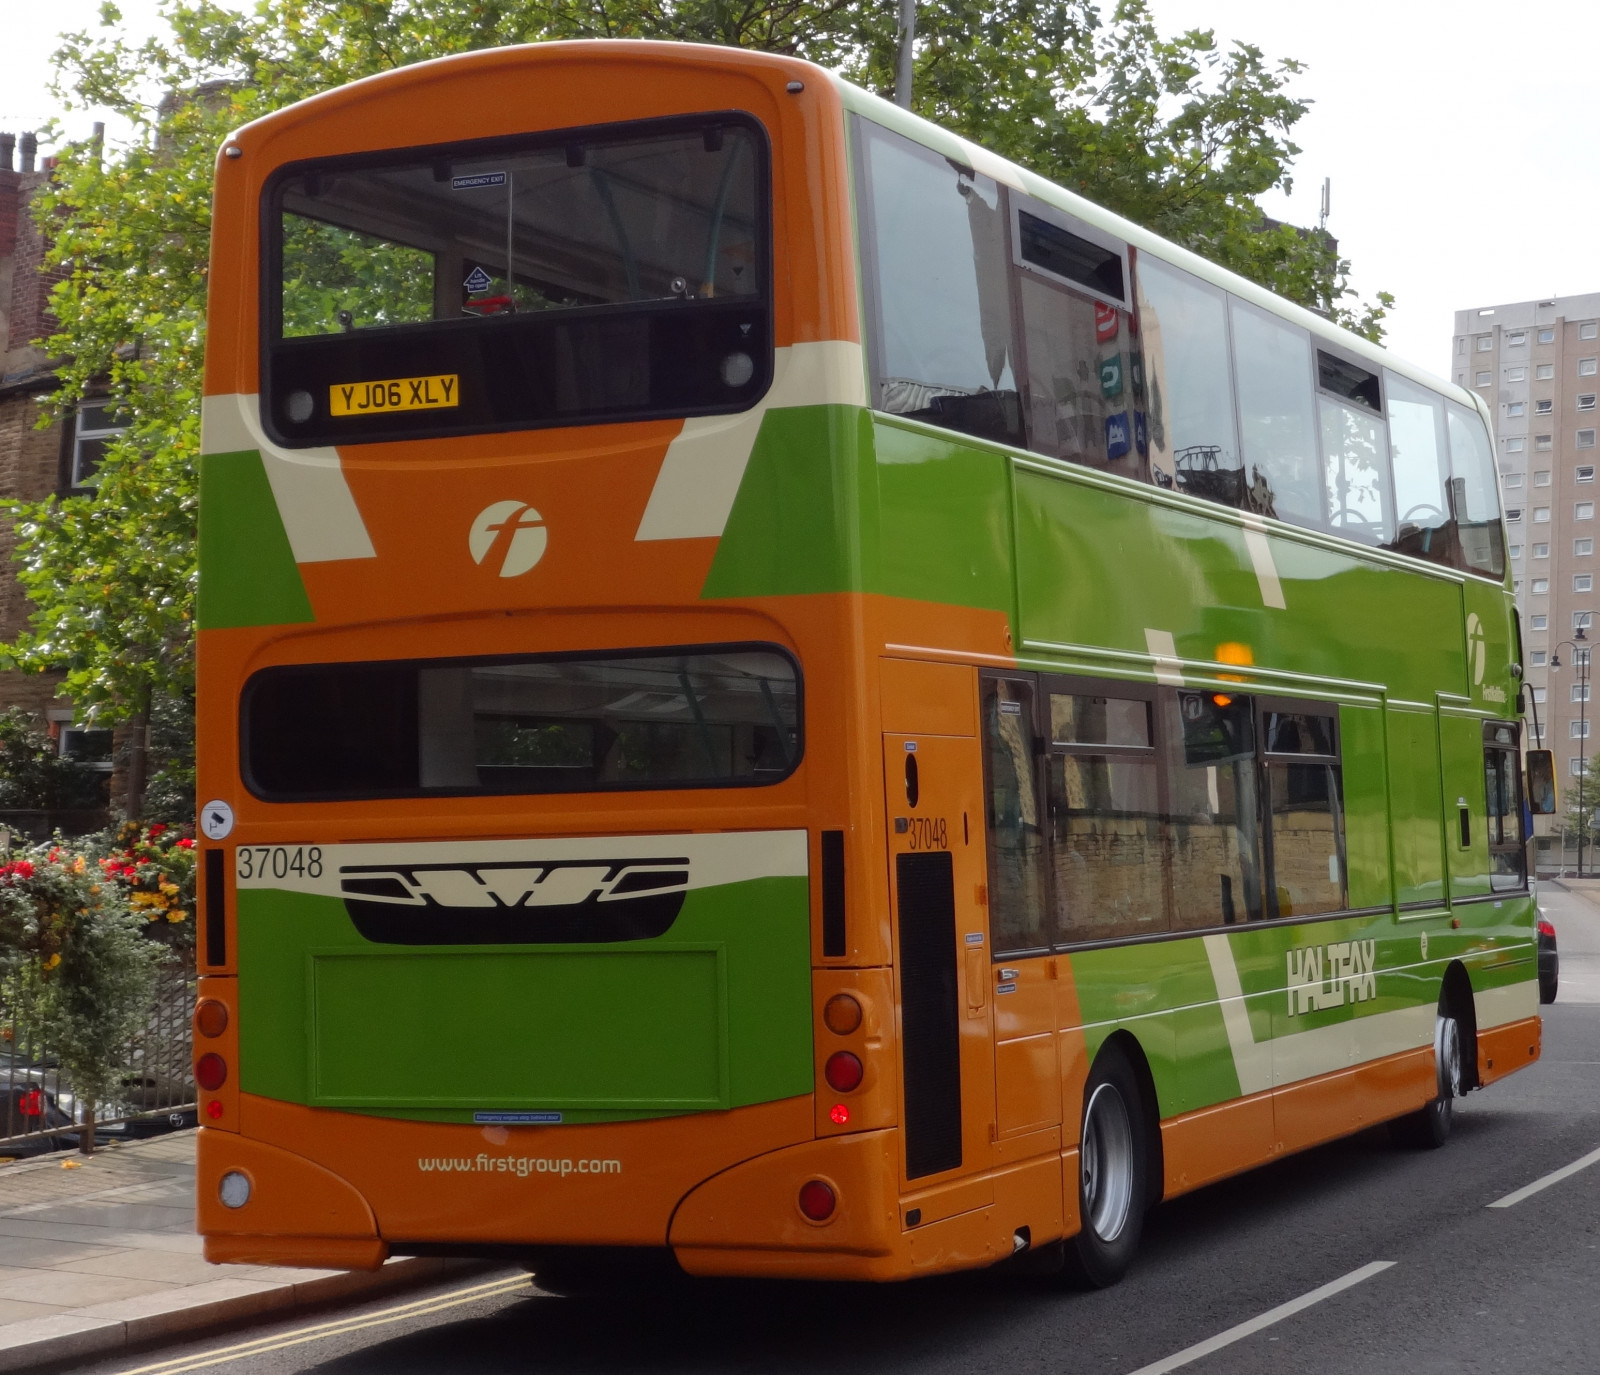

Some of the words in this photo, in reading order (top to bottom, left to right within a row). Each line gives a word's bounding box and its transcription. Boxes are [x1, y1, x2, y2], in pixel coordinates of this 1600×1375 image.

[453, 177, 490, 187] EMERGENCY
[490, 175, 504, 183] EXIT
[341, 382, 401, 410] YJ06
[409, 378, 454, 405] XLY
[909, 817, 948, 850] 37048
[238, 847, 323, 879] 37048
[1286, 938, 1376, 1018] HALIFAX
[418, 1153, 621, 1177] www.firstgroup.com
